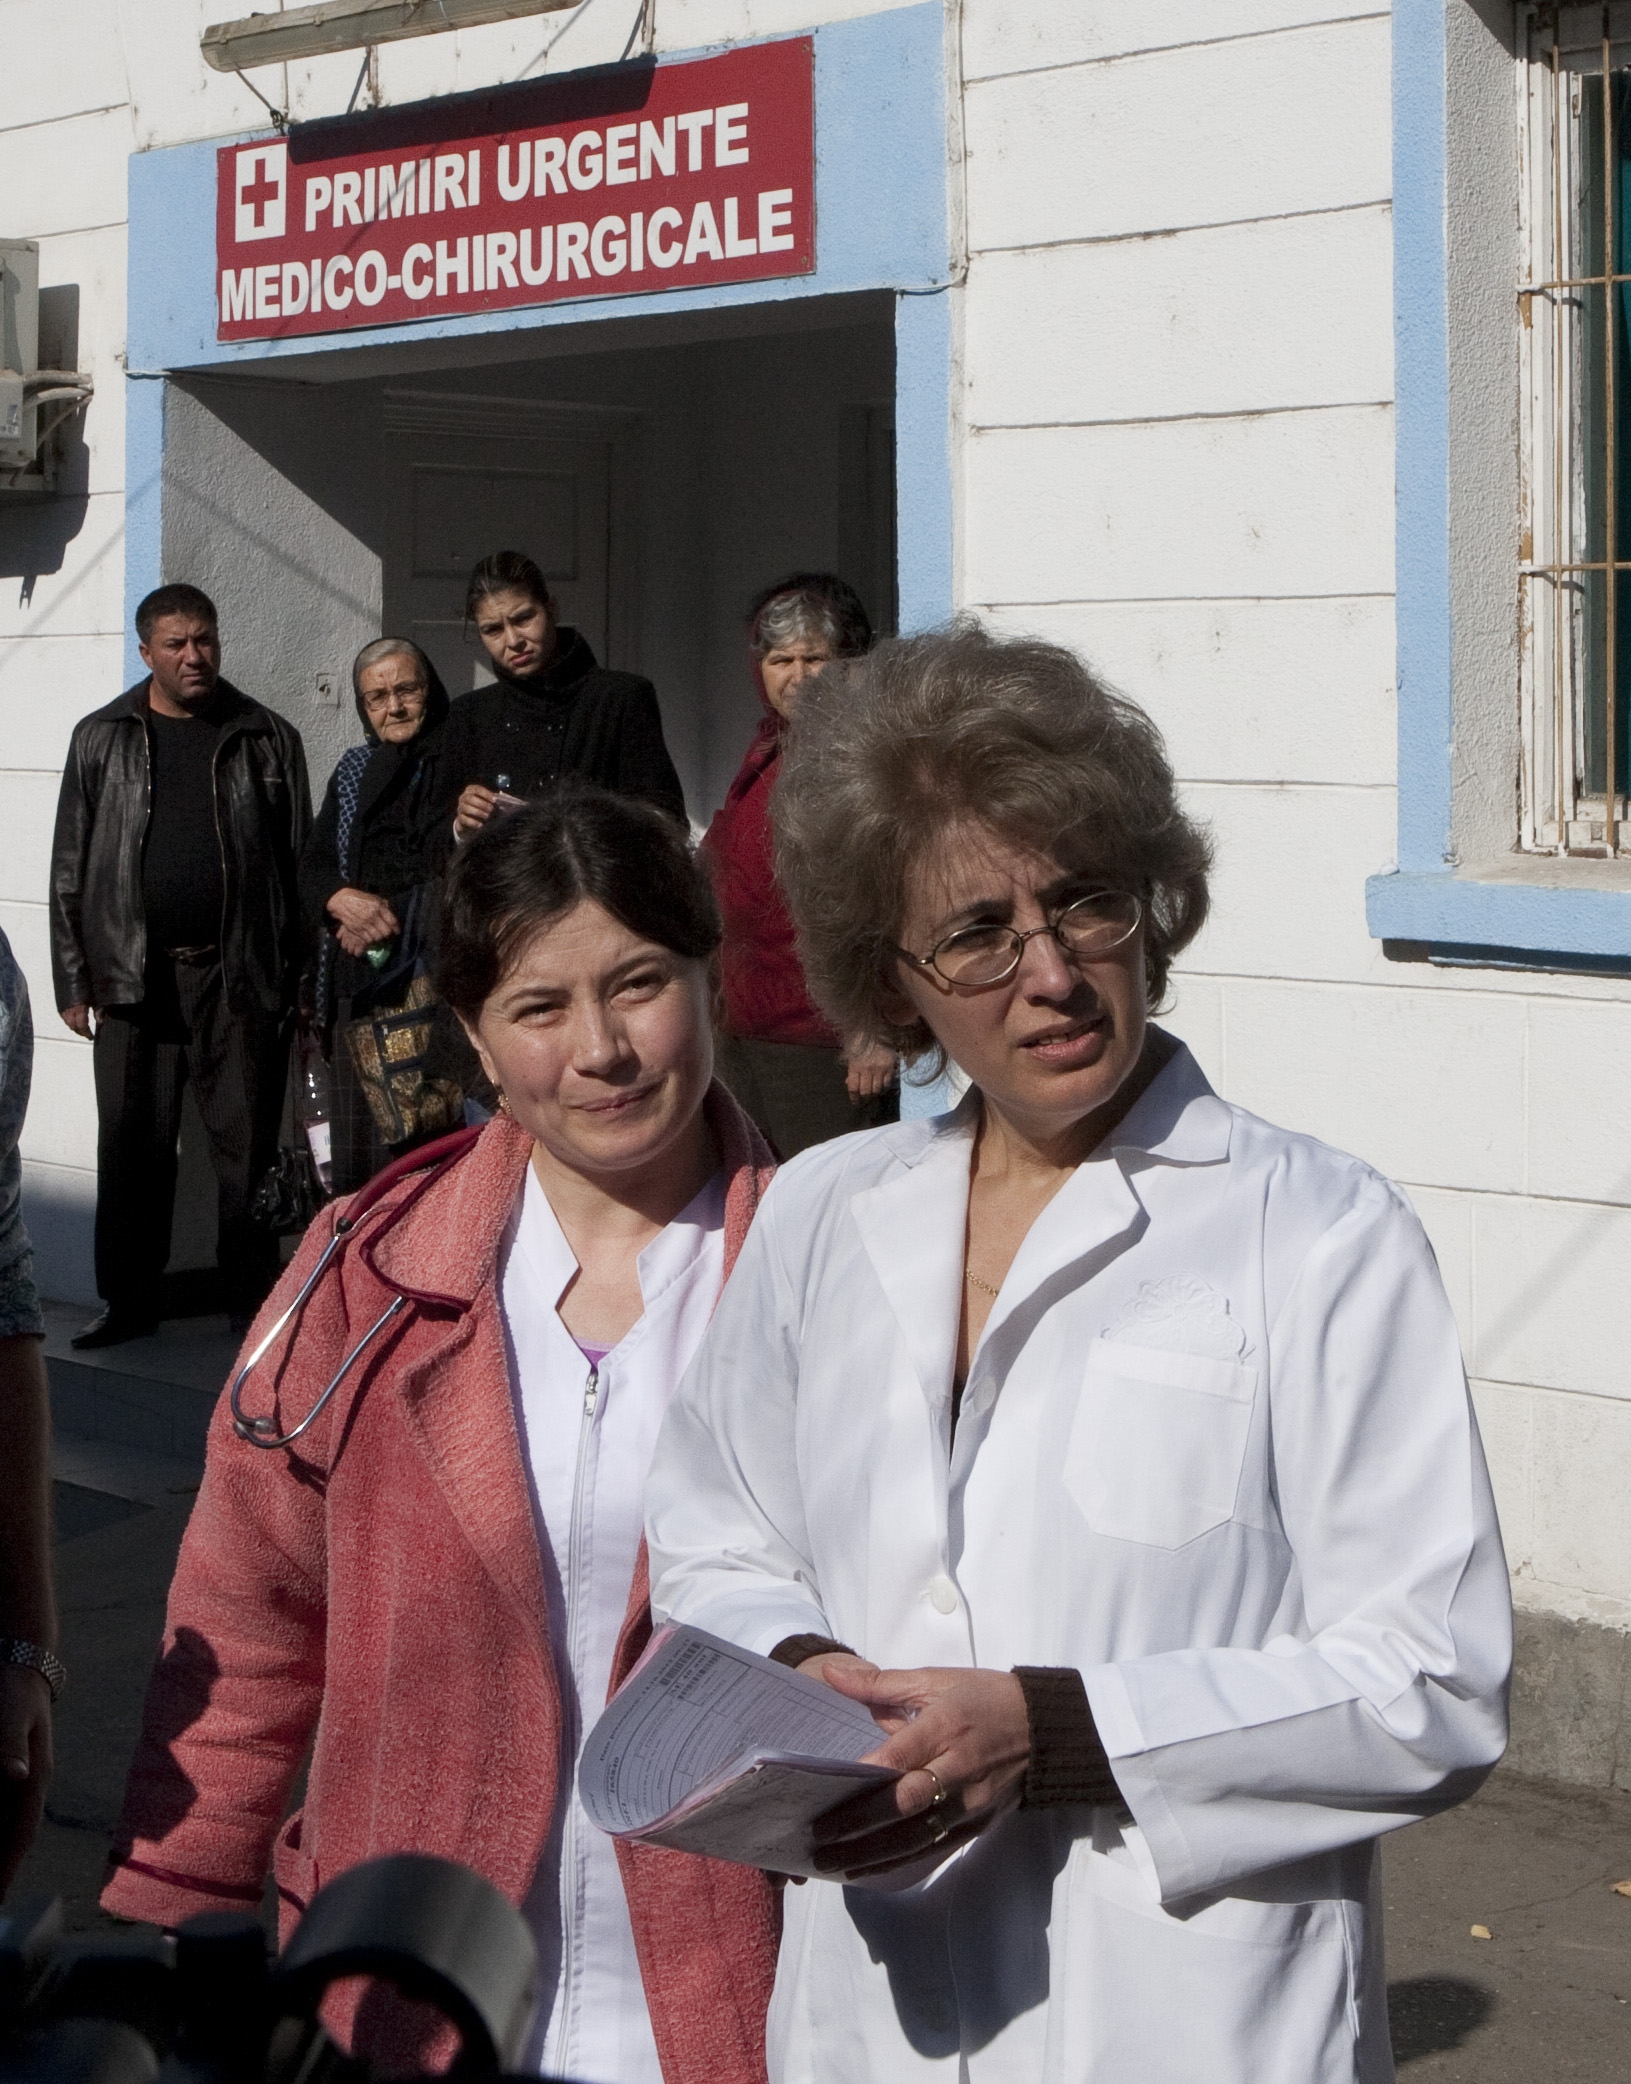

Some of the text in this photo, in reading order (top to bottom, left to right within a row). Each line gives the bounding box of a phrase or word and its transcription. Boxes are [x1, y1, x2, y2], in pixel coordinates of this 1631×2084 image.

[305, 102, 750, 232] PRIMIRI URGENTE
[221, 188, 795, 323] MEDICO-CHIRURGICALE
